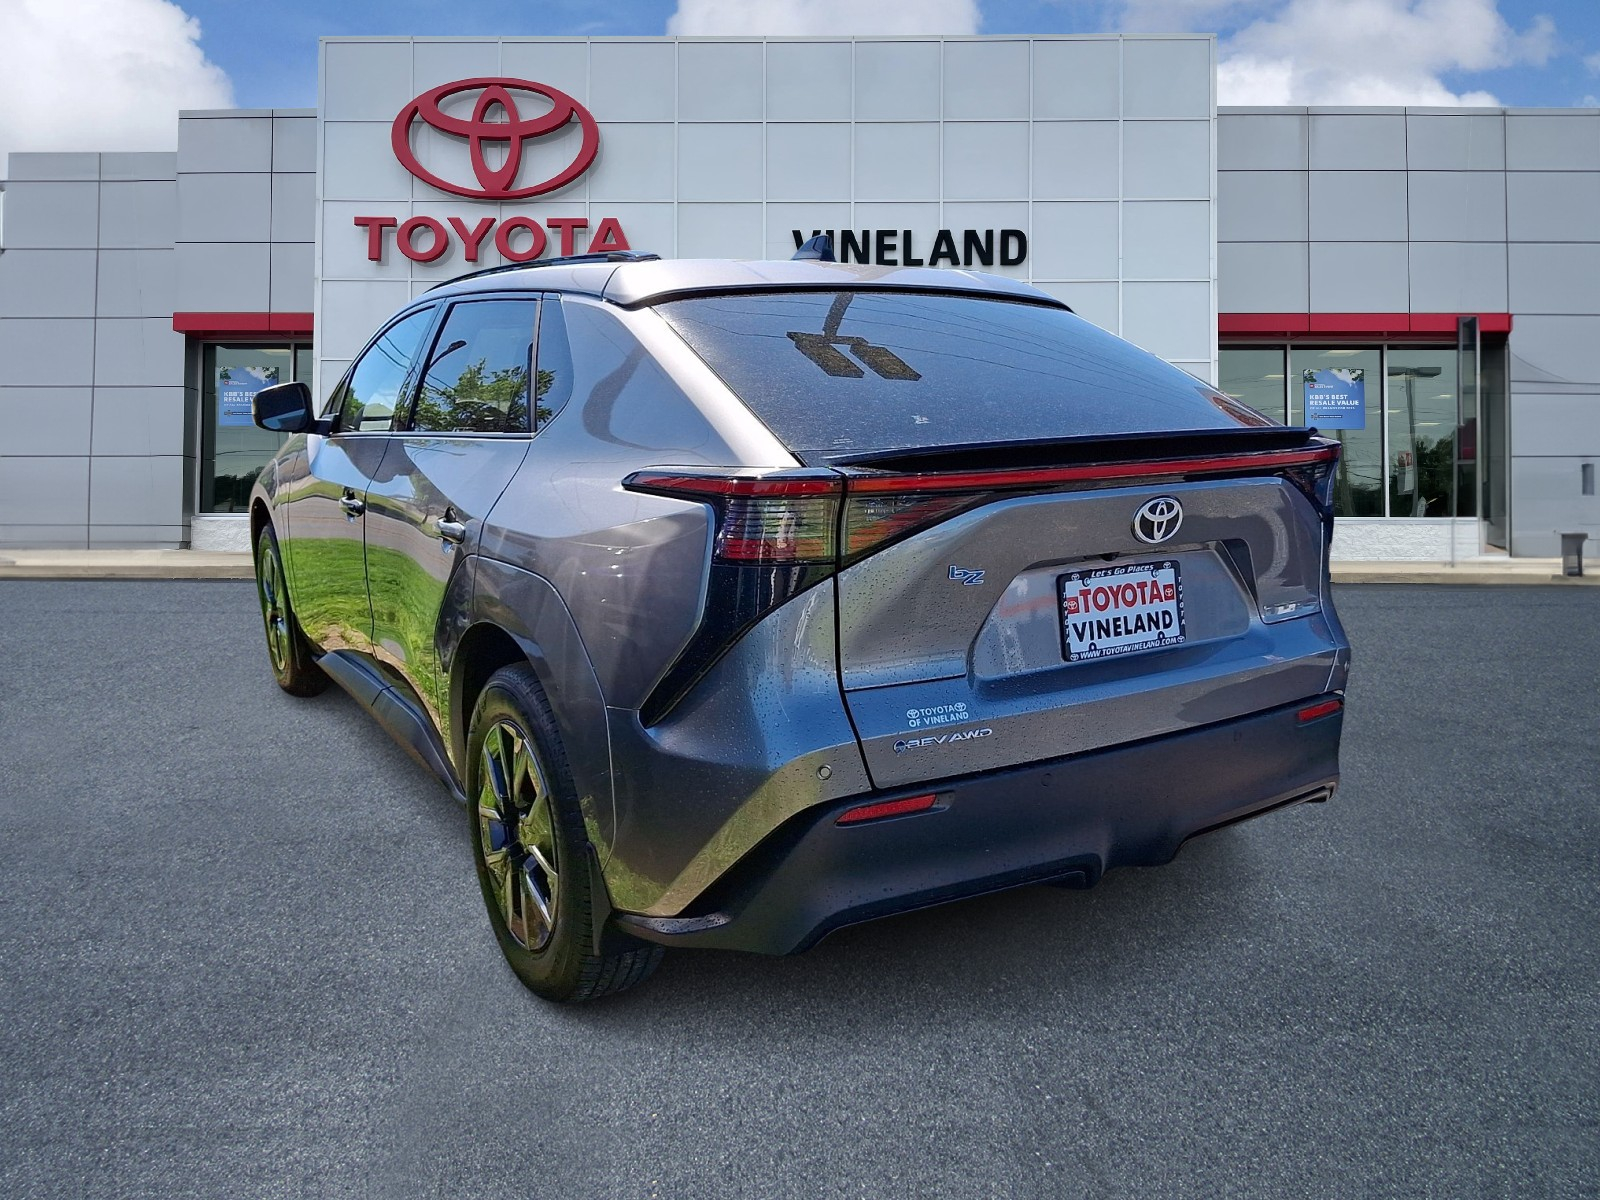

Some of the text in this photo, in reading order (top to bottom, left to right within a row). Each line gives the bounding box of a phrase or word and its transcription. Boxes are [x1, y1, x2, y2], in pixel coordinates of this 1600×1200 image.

[354, 216, 631, 262] TOYOTA
[1091, 564, 1155, 578] Let's Go Places
[1079, 579, 1164, 614] TOYOTA
[1177, 576, 1186, 625] TOYOTA
[1072, 609, 1173, 643] VINELAND
[1080, 637, 1177, 660] WWW.TOYOTAVINELAND.COM
[908, 711, 969, 728] OF VINELAND
[920, 704, 955, 717] TOYOTA
[948, 728, 993, 743] AWD
